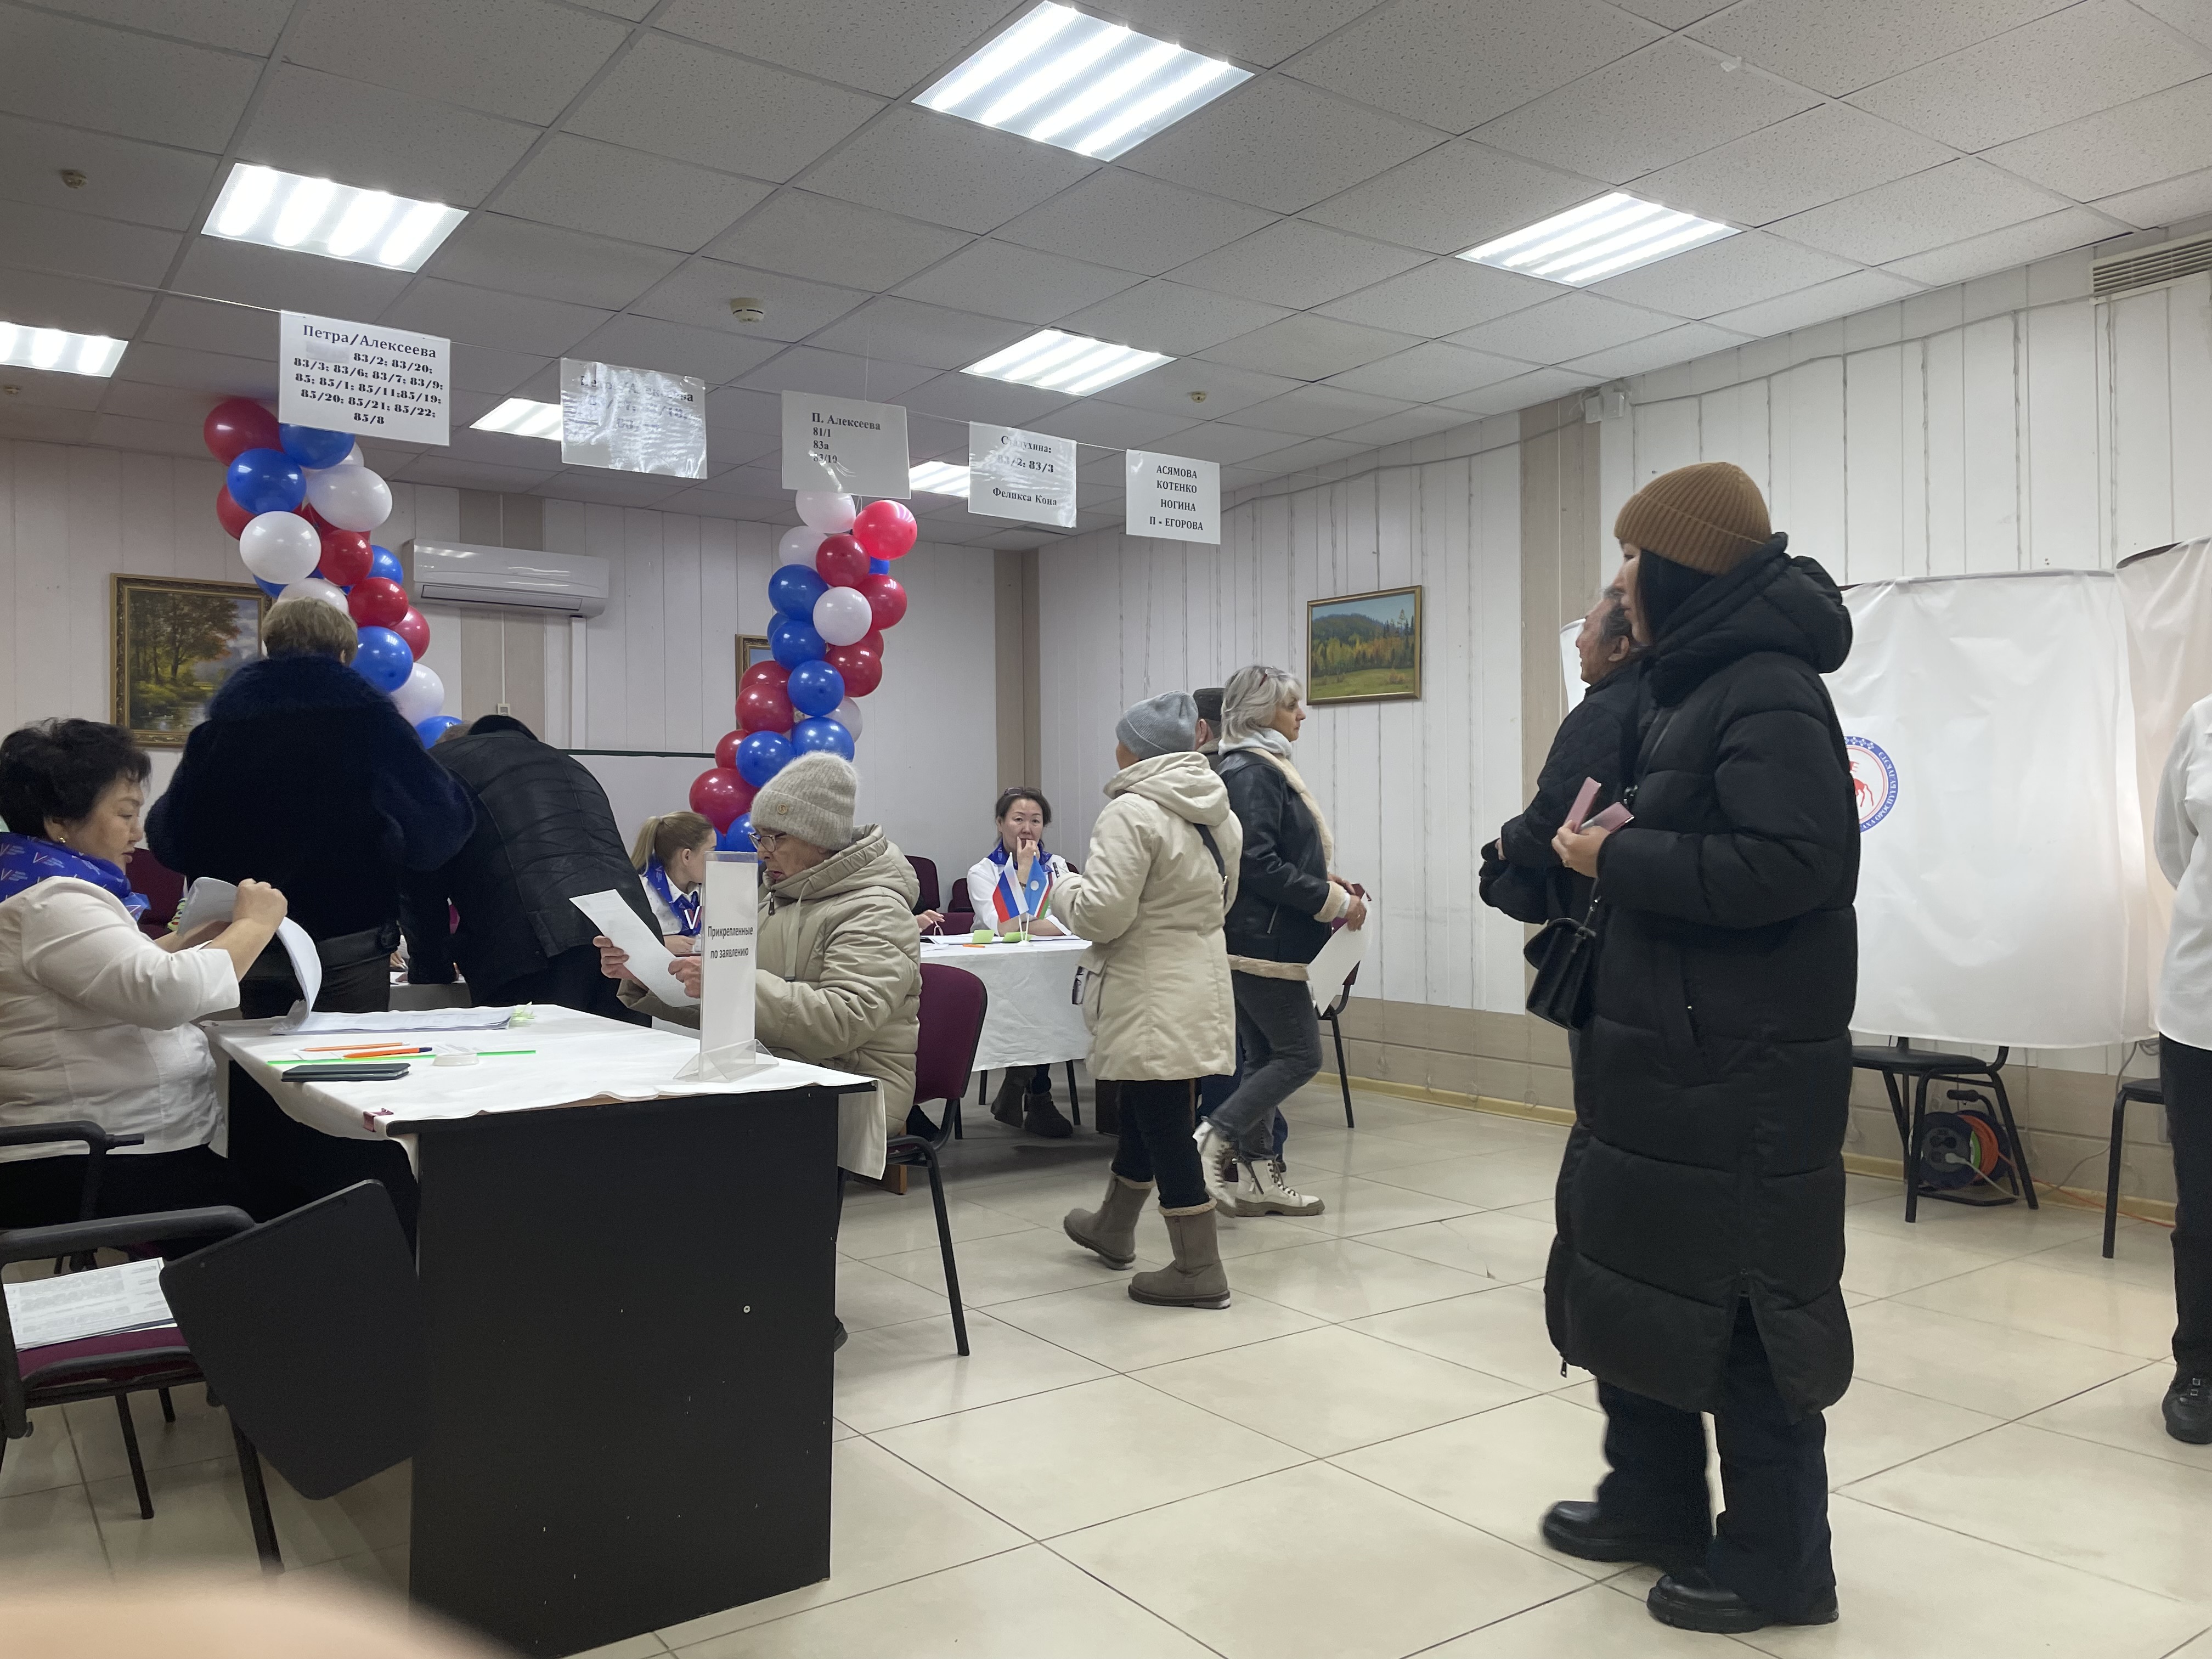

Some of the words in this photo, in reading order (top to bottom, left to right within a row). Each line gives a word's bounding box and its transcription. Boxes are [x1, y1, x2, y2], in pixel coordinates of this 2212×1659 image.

[303, 325, 436, 358] Петра/Алексеева
[353, 412, 385, 425] 85/8
[811, 412, 824, 423] П.
[827, 415, 881, 430] Алексеева
[813, 427, 831, 437] 81/1
[813, 440, 829, 450] 83а
[1029, 460, 1054, 473] 83/3
[1156, 465, 1198, 478] АСЯМОВА
[1156, 480, 1197, 493] КОТЕНКО
[993, 488, 1032, 501] Феликса
[1035, 494, 1057, 506] Кона
[1161, 499, 1196, 511] НОГИНА
[1149, 516, 1155, 524] П
[1165, 518, 1203, 531] ЕГОРОВА
[708, 926, 753, 940] Прикрепленные
[710, 950, 718, 959] по
[719, 947, 749, 958] заявлению
